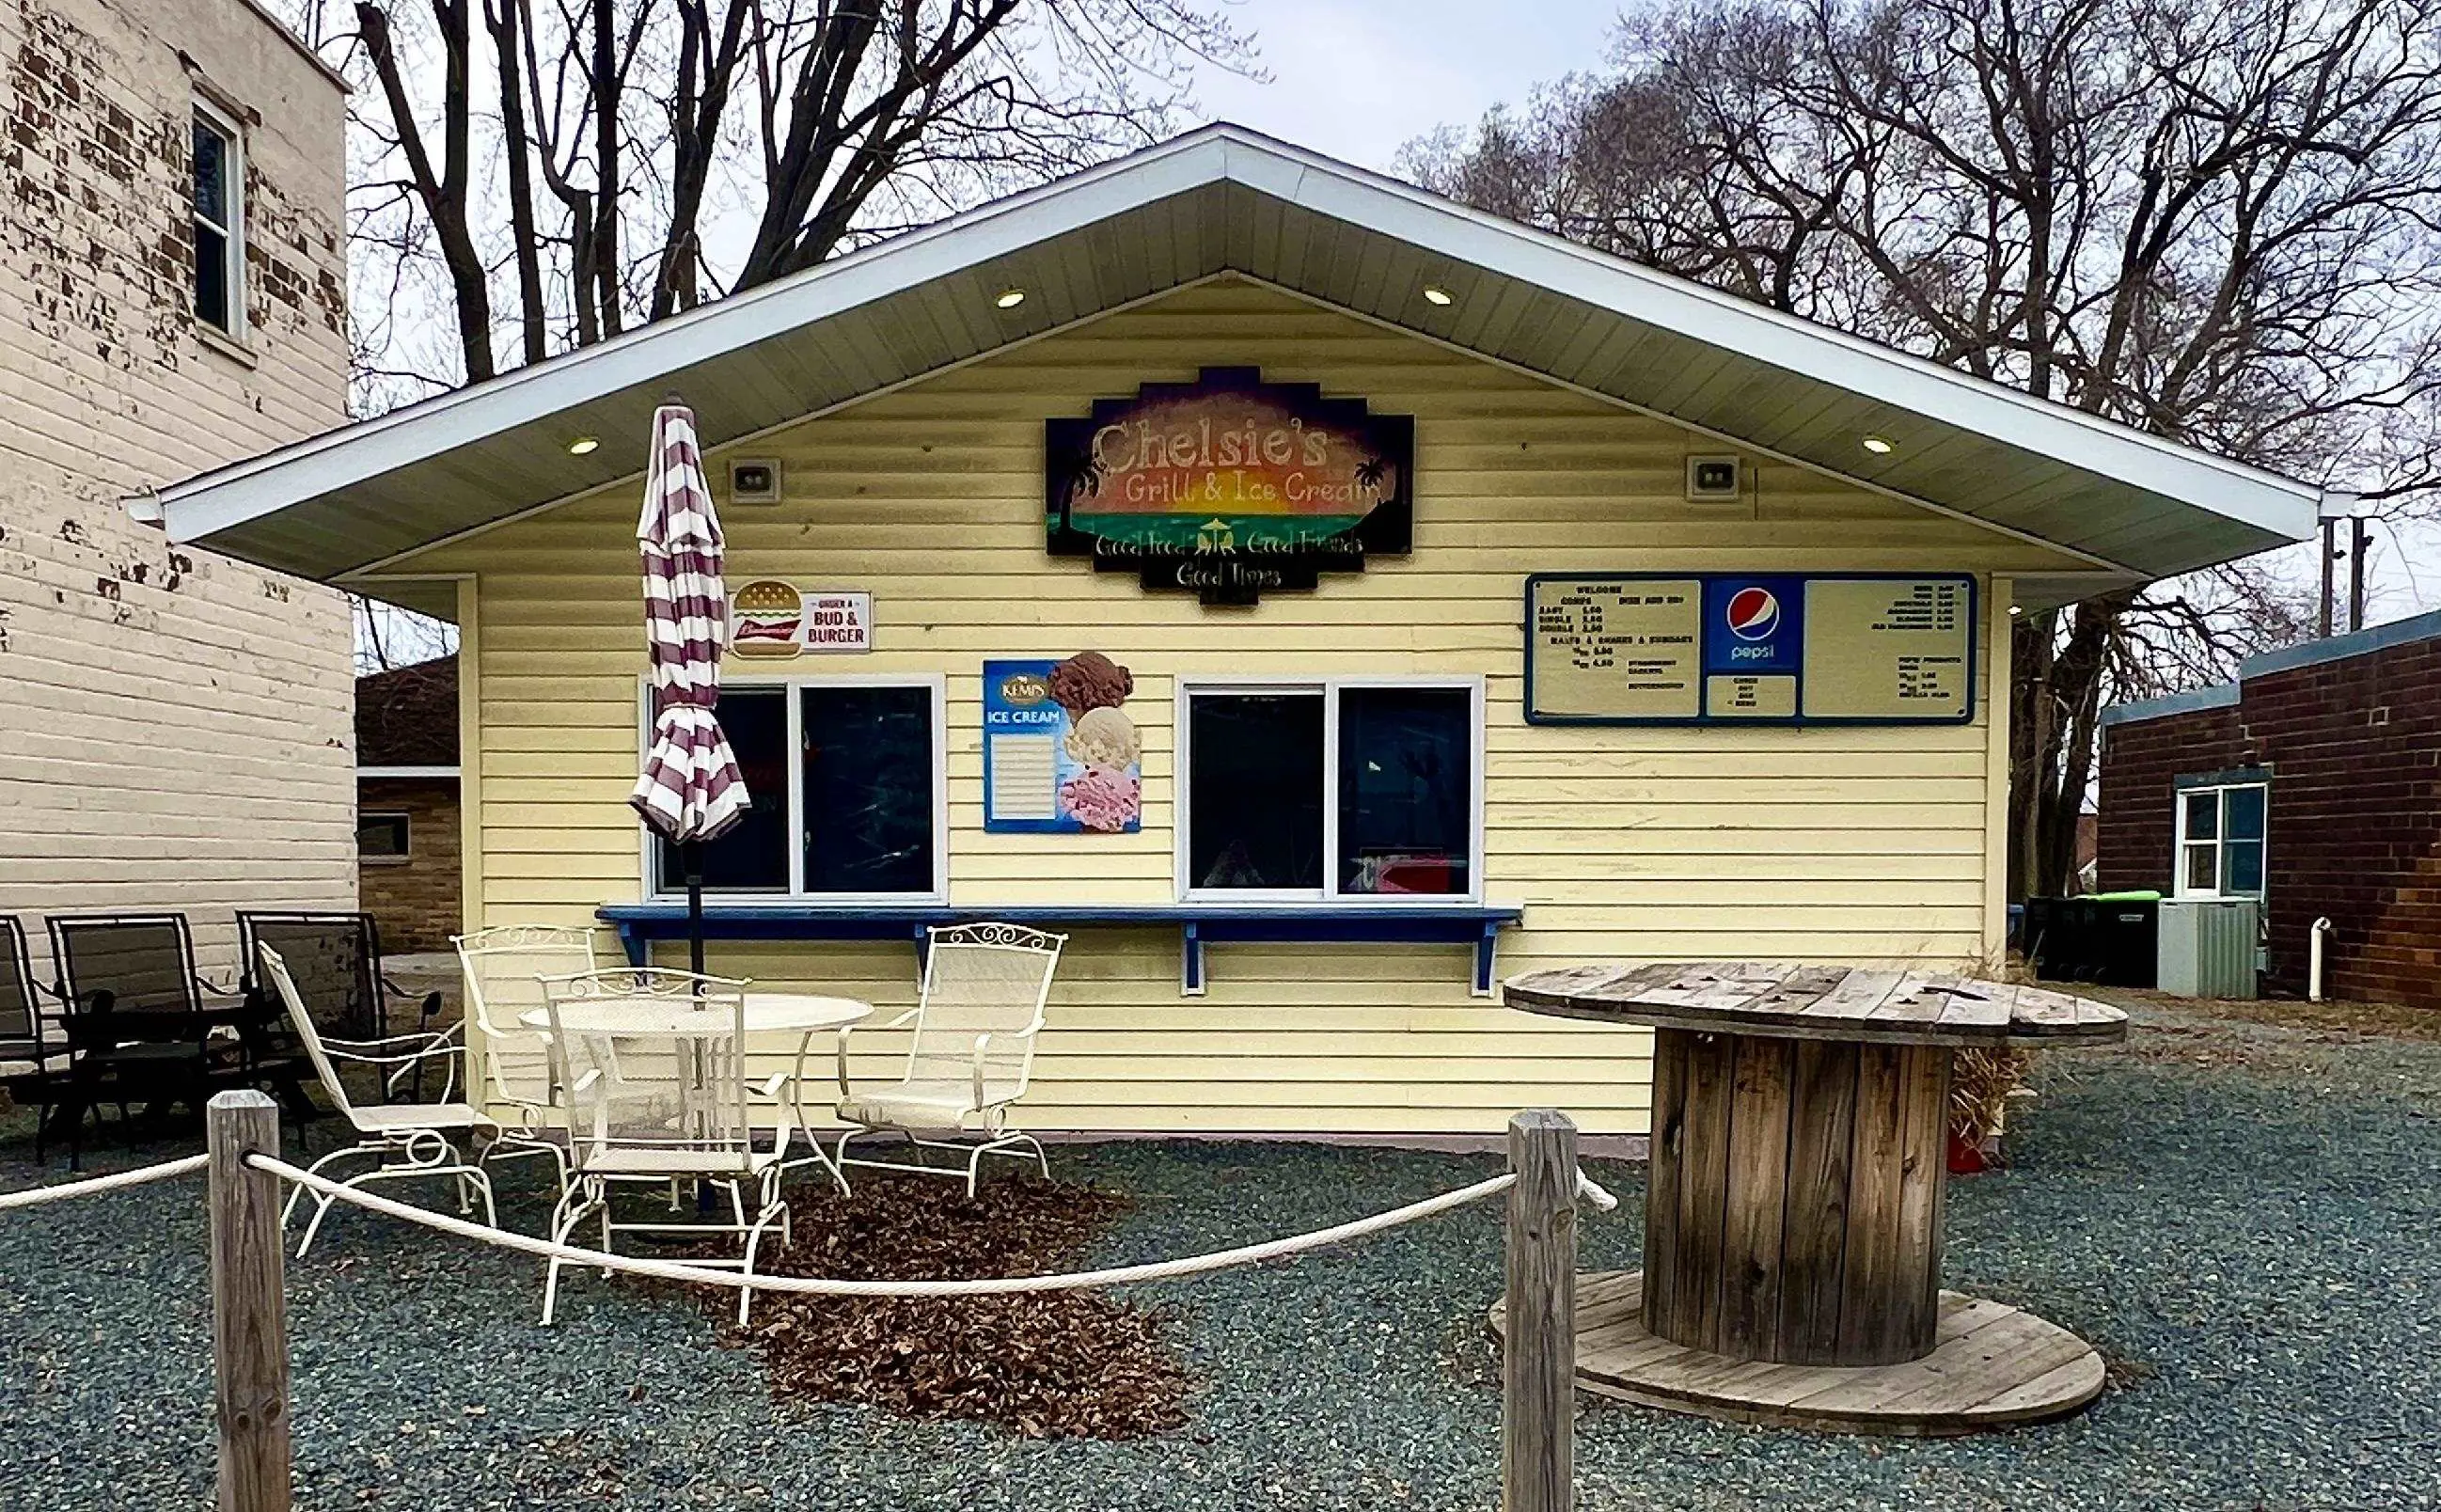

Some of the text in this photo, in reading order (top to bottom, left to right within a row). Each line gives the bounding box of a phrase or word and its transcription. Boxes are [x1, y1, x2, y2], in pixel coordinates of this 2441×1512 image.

[1092, 417, 1328, 475] Chelsie's
[1126, 469, 1383, 503] Grill & Ice Cream
[813, 611, 858, 626] BUD &
[808, 628, 864, 643] BURGER
[1730, 644, 1774, 660] pepsi
[988, 711, 1060, 724] ICE CREAM
